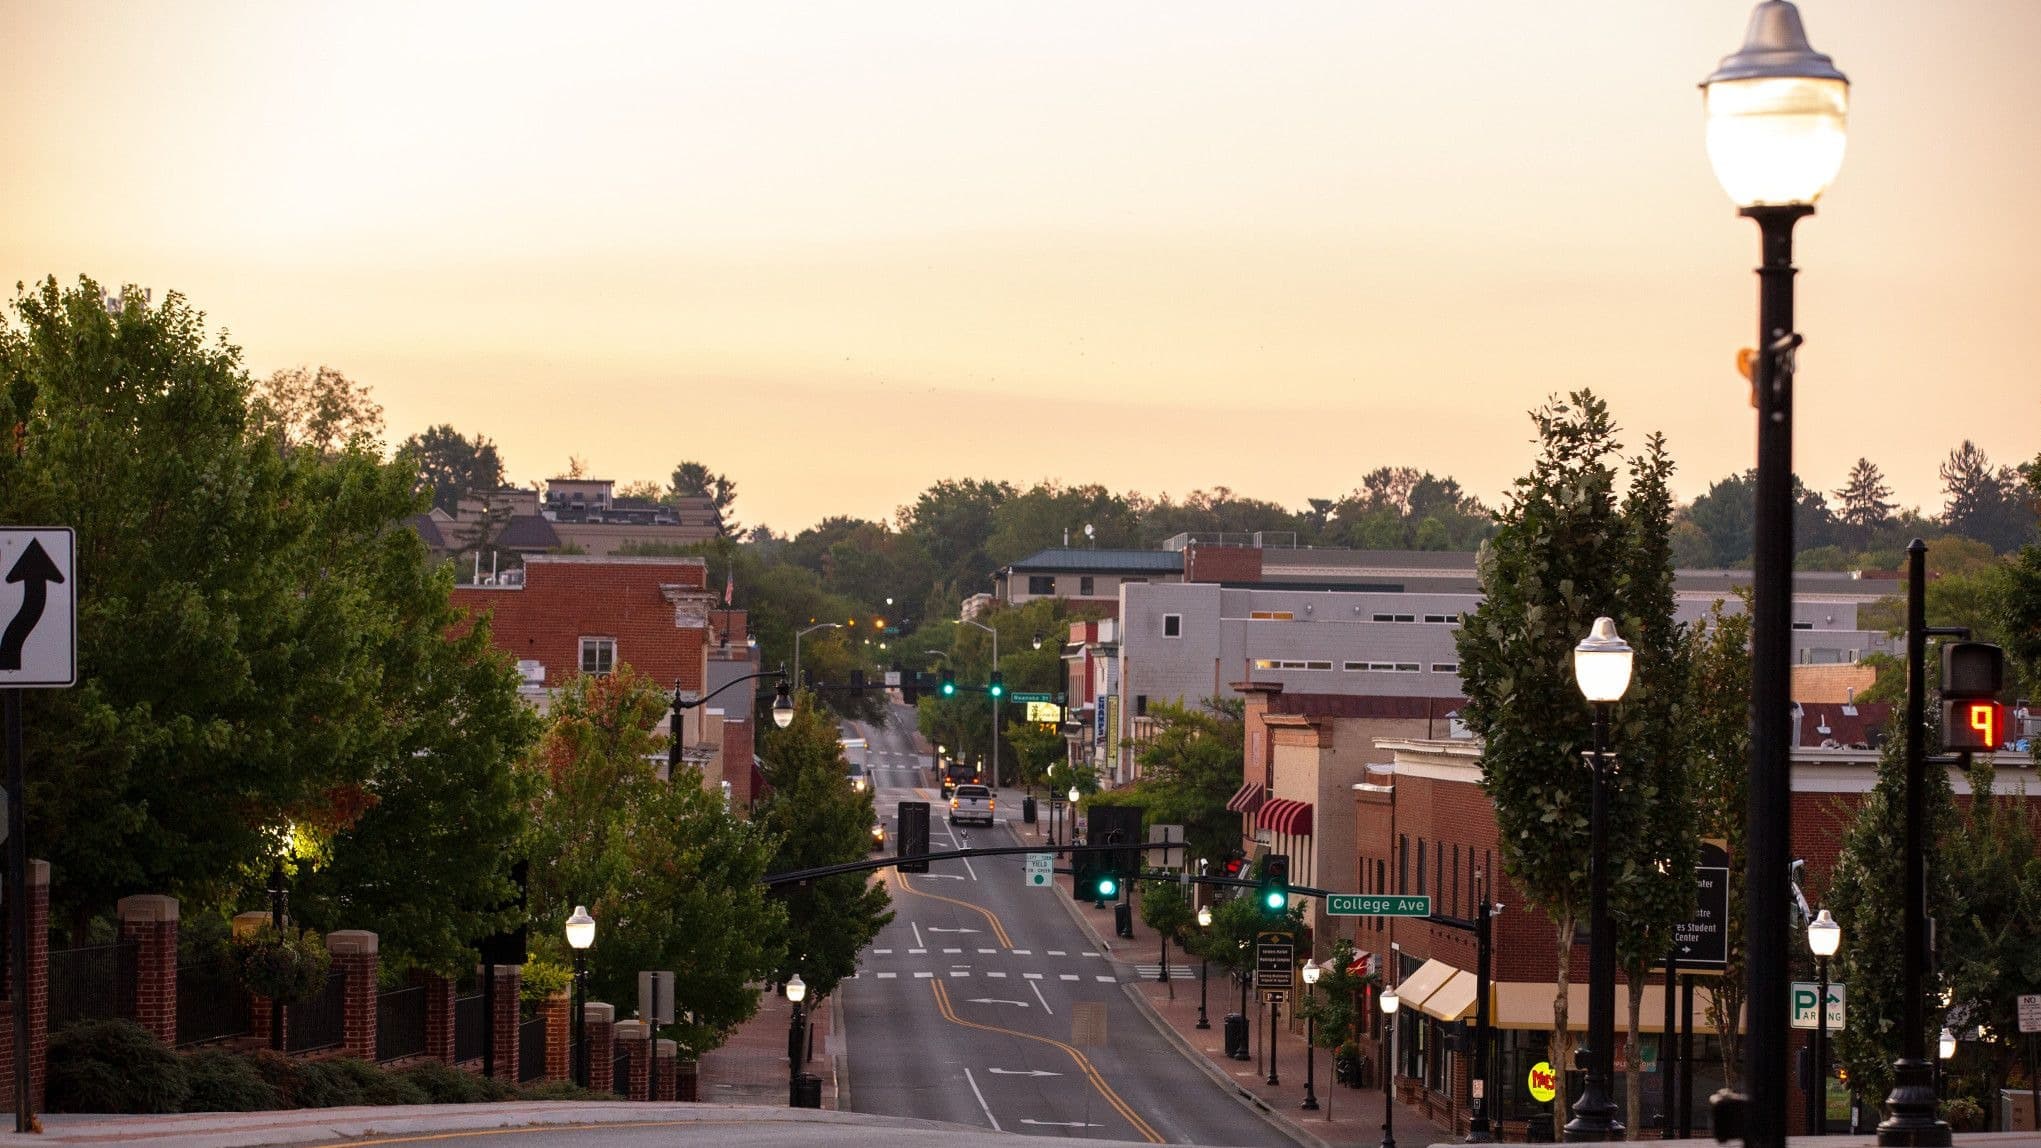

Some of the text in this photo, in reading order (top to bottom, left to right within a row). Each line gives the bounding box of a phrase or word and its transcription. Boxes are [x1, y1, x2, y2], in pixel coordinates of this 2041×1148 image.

[1971, 706, 1993, 747] 9
[1333, 898, 1425, 913] College Ave
[1687, 923, 1717, 933] Student
[1675, 932, 1699, 942] Center
[1795, 991, 1841, 1021] PARNG
